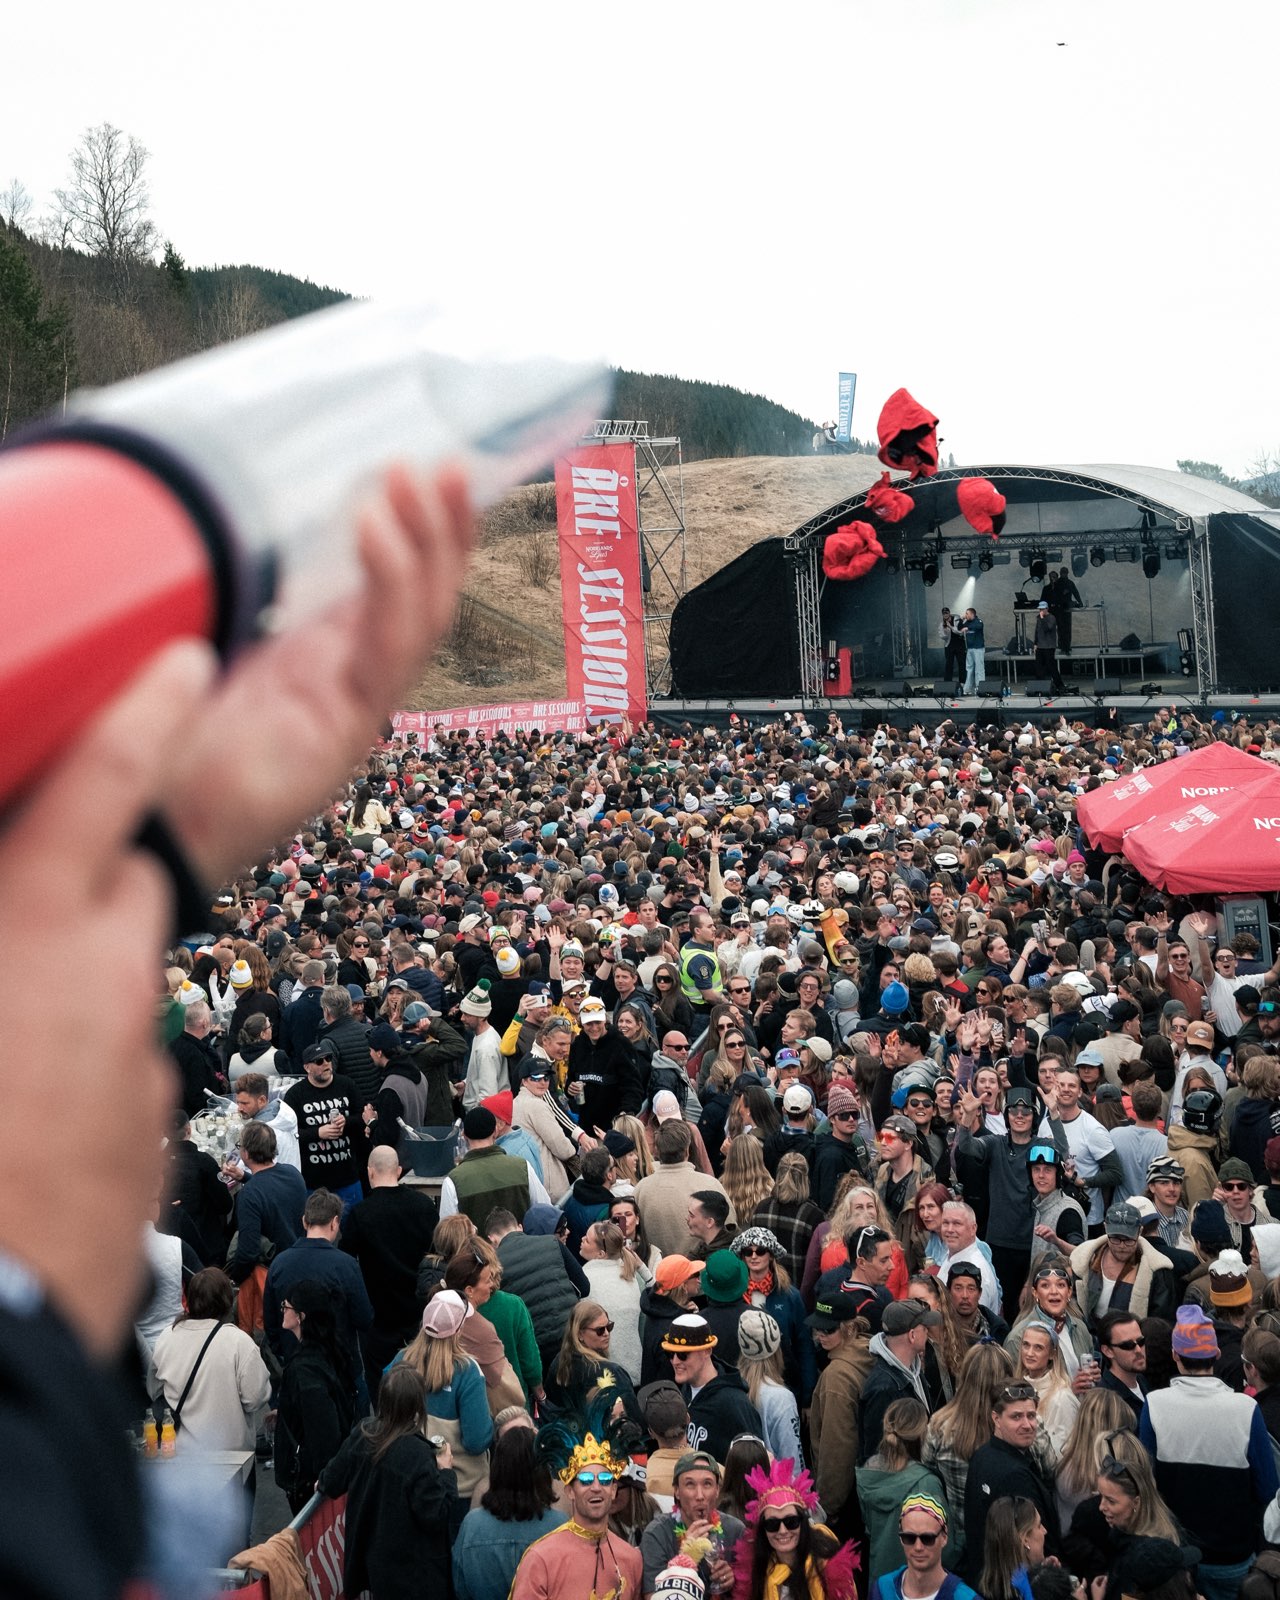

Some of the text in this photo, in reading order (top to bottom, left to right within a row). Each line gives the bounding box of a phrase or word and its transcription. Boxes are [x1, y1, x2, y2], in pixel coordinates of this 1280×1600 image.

[571, 466, 629, 540] ÅRE
[533, 702, 548, 717] ÅRE
[548, 701, 580, 716] SESSIONS
[566, 715, 580, 730] ÅRE
